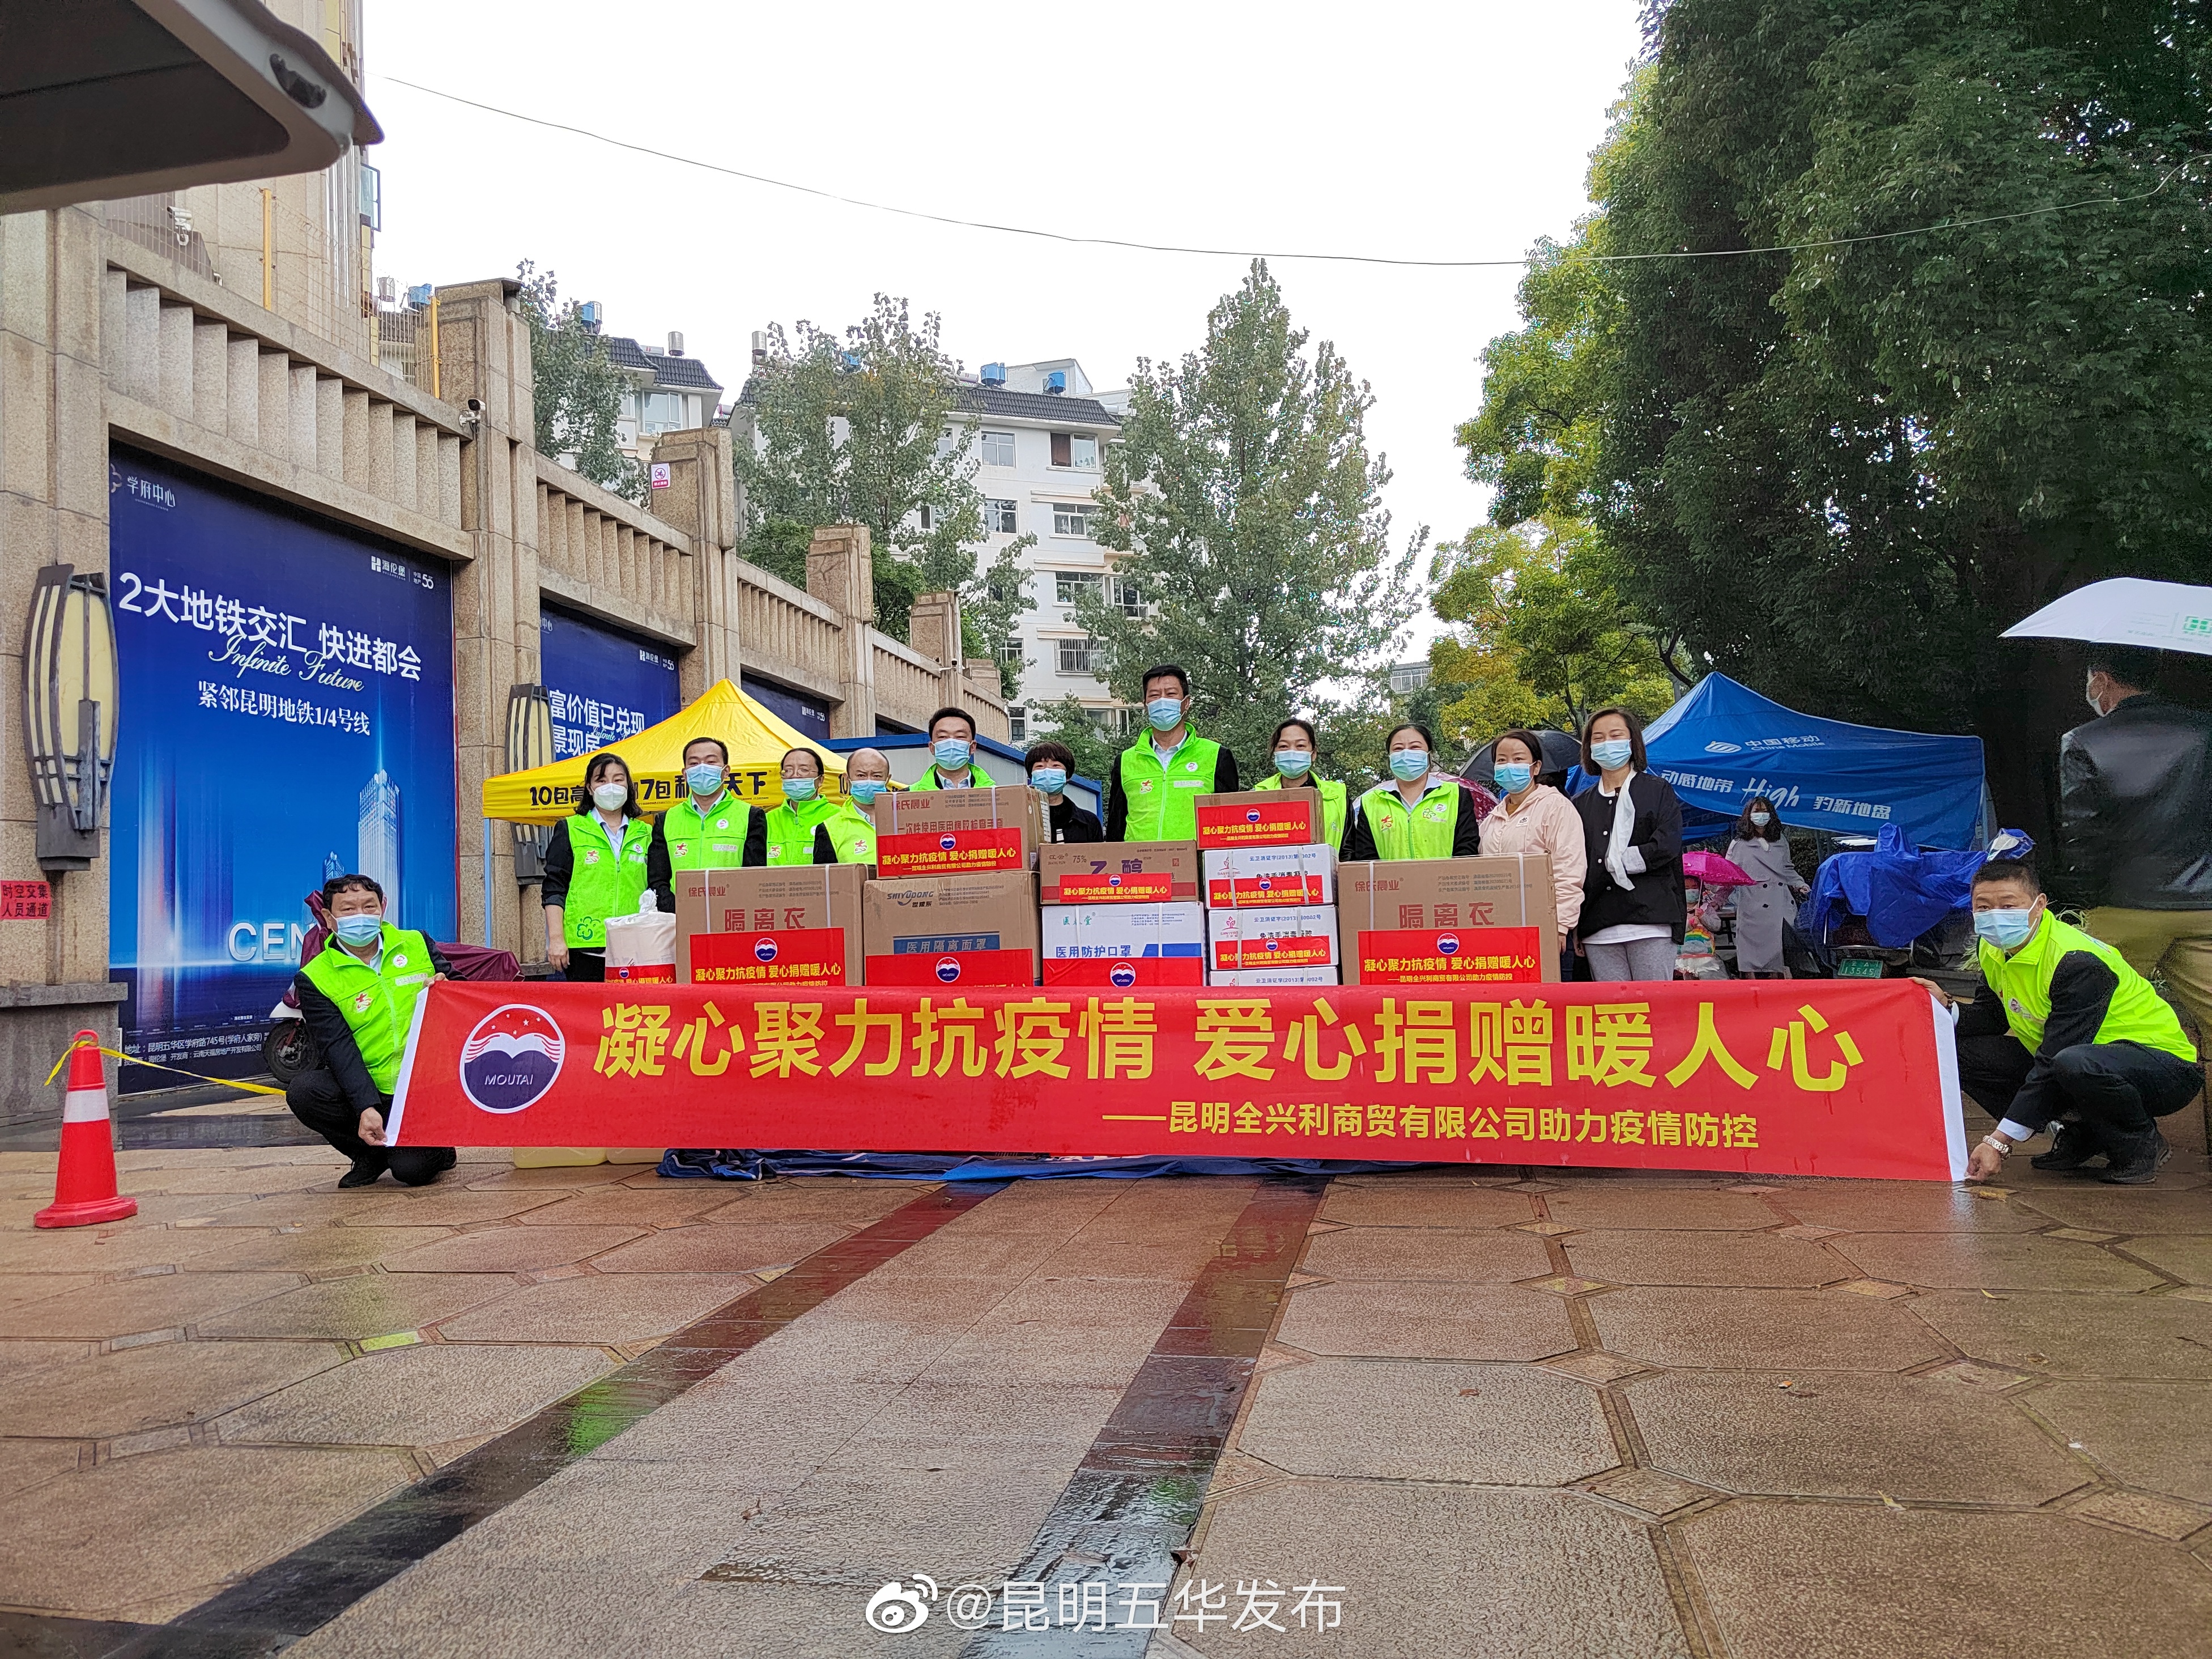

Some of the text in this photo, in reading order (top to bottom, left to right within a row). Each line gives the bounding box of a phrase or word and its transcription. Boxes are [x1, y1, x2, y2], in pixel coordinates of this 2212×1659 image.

[127, 475, 176, 508] 学府中心
[382, 559, 406, 577] 海伦堡
[118, 572, 422, 682] 2大地铁交汇 快进都会
[209, 635, 365, 691] Infinite Future
[198, 680, 371, 737] 紧邻昆明地铁1/4号线
[550, 690, 645, 735] 富价值已兑现
[1744, 734, 1820, 747] 中国移动
[1661, 769, 1734, 793] 动感地带
[1741, 777, 1800, 808] High
[882, 852, 947, 865] 凝心聚力抗疫情
[949, 847, 1016, 861] 爱心捐赠暖人心
[1073, 855, 1087, 863] 75%
[2, 902, 48, 917] 人员通道
[725, 907, 806, 931] 隔离衣
[1399, 901, 1495, 929] 隔离衣
[907, 938, 986, 953] 医用隔离面罩
[1056, 945, 1132, 958] 医用防护口罩
[695, 962, 841, 981] 凝心聚力抗疫情 爱心捐赠暖人心
[1364, 955, 1535, 972] 凝心聚力抗疫情 爱心捐赠暖人心
[593, 997, 1865, 1092] 凝心聚力抗疫情 爱心捐赠暖人心
[484, 1074, 534, 1086] MOUTAI
